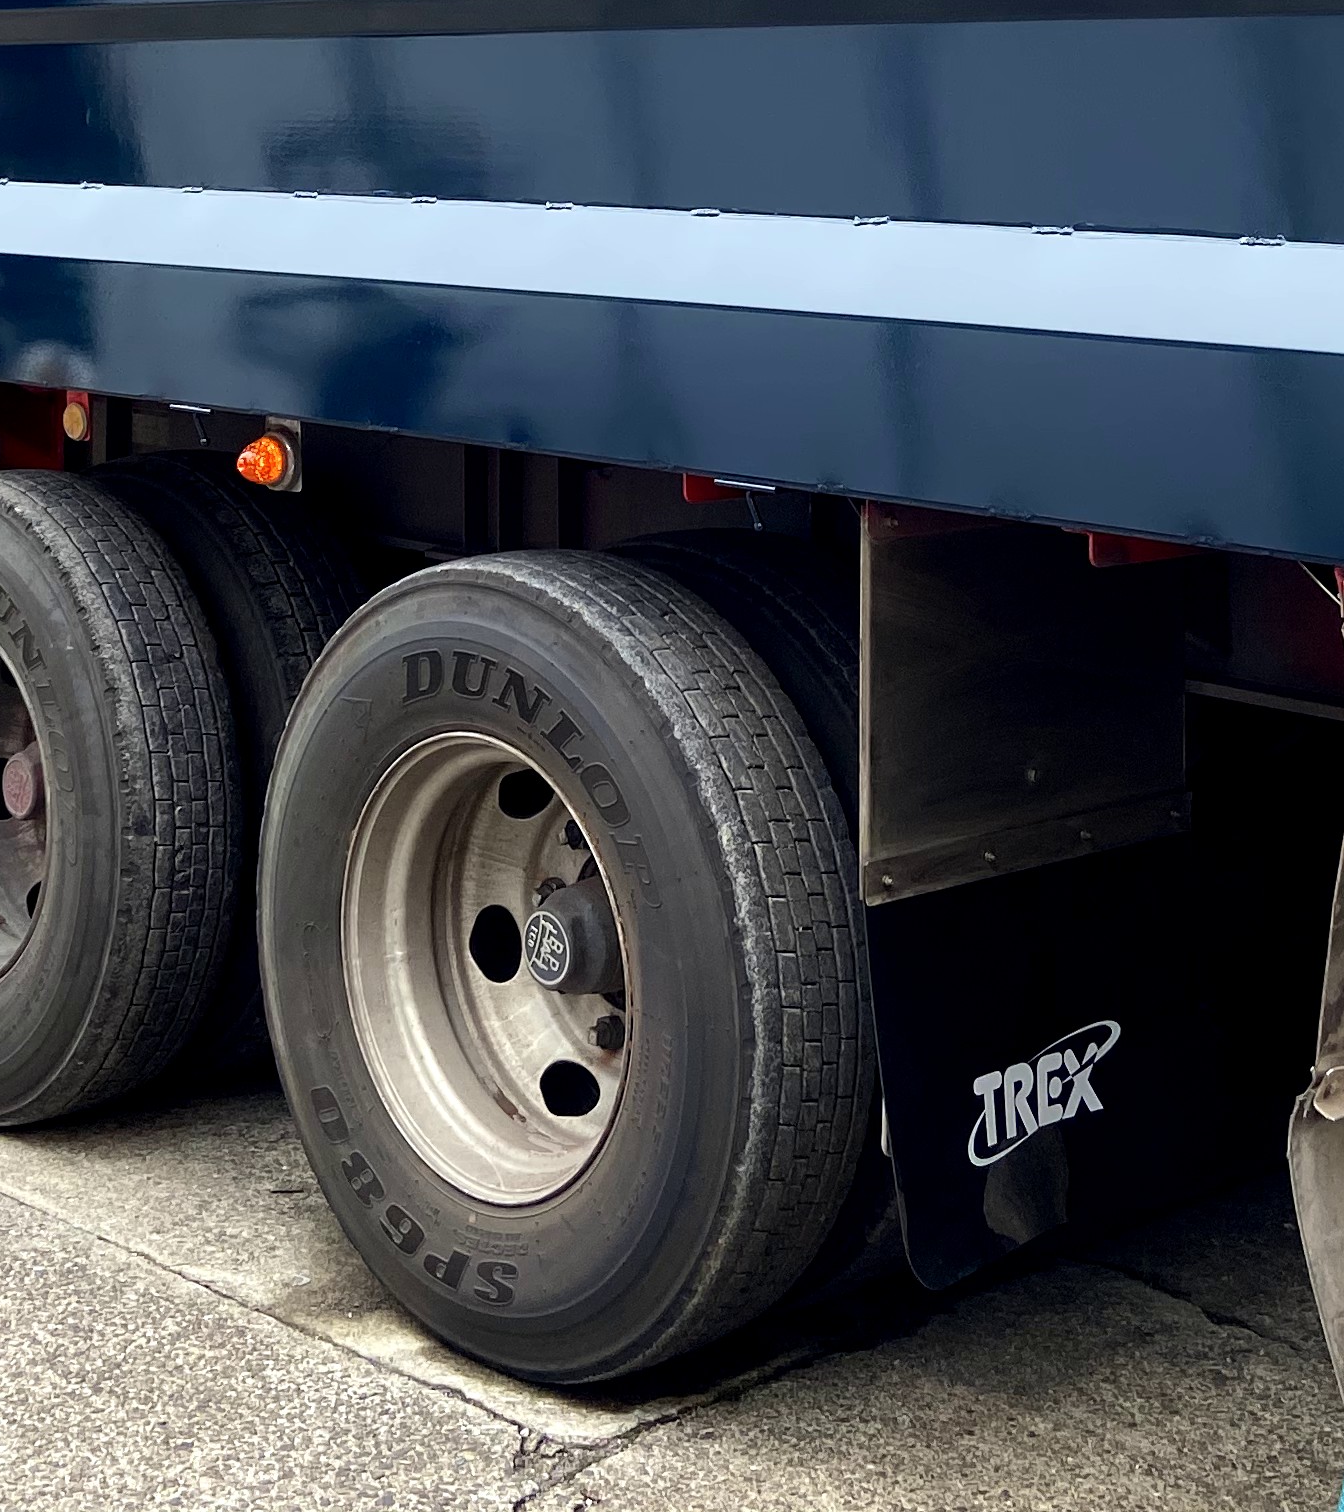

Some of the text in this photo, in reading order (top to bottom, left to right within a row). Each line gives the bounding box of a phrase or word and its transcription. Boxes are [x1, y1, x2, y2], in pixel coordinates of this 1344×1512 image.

[402, 647, 662, 908] DUNLOP
[310, 1085, 520, 1307] SP680
[972, 1042, 1105, 1148] TREX
